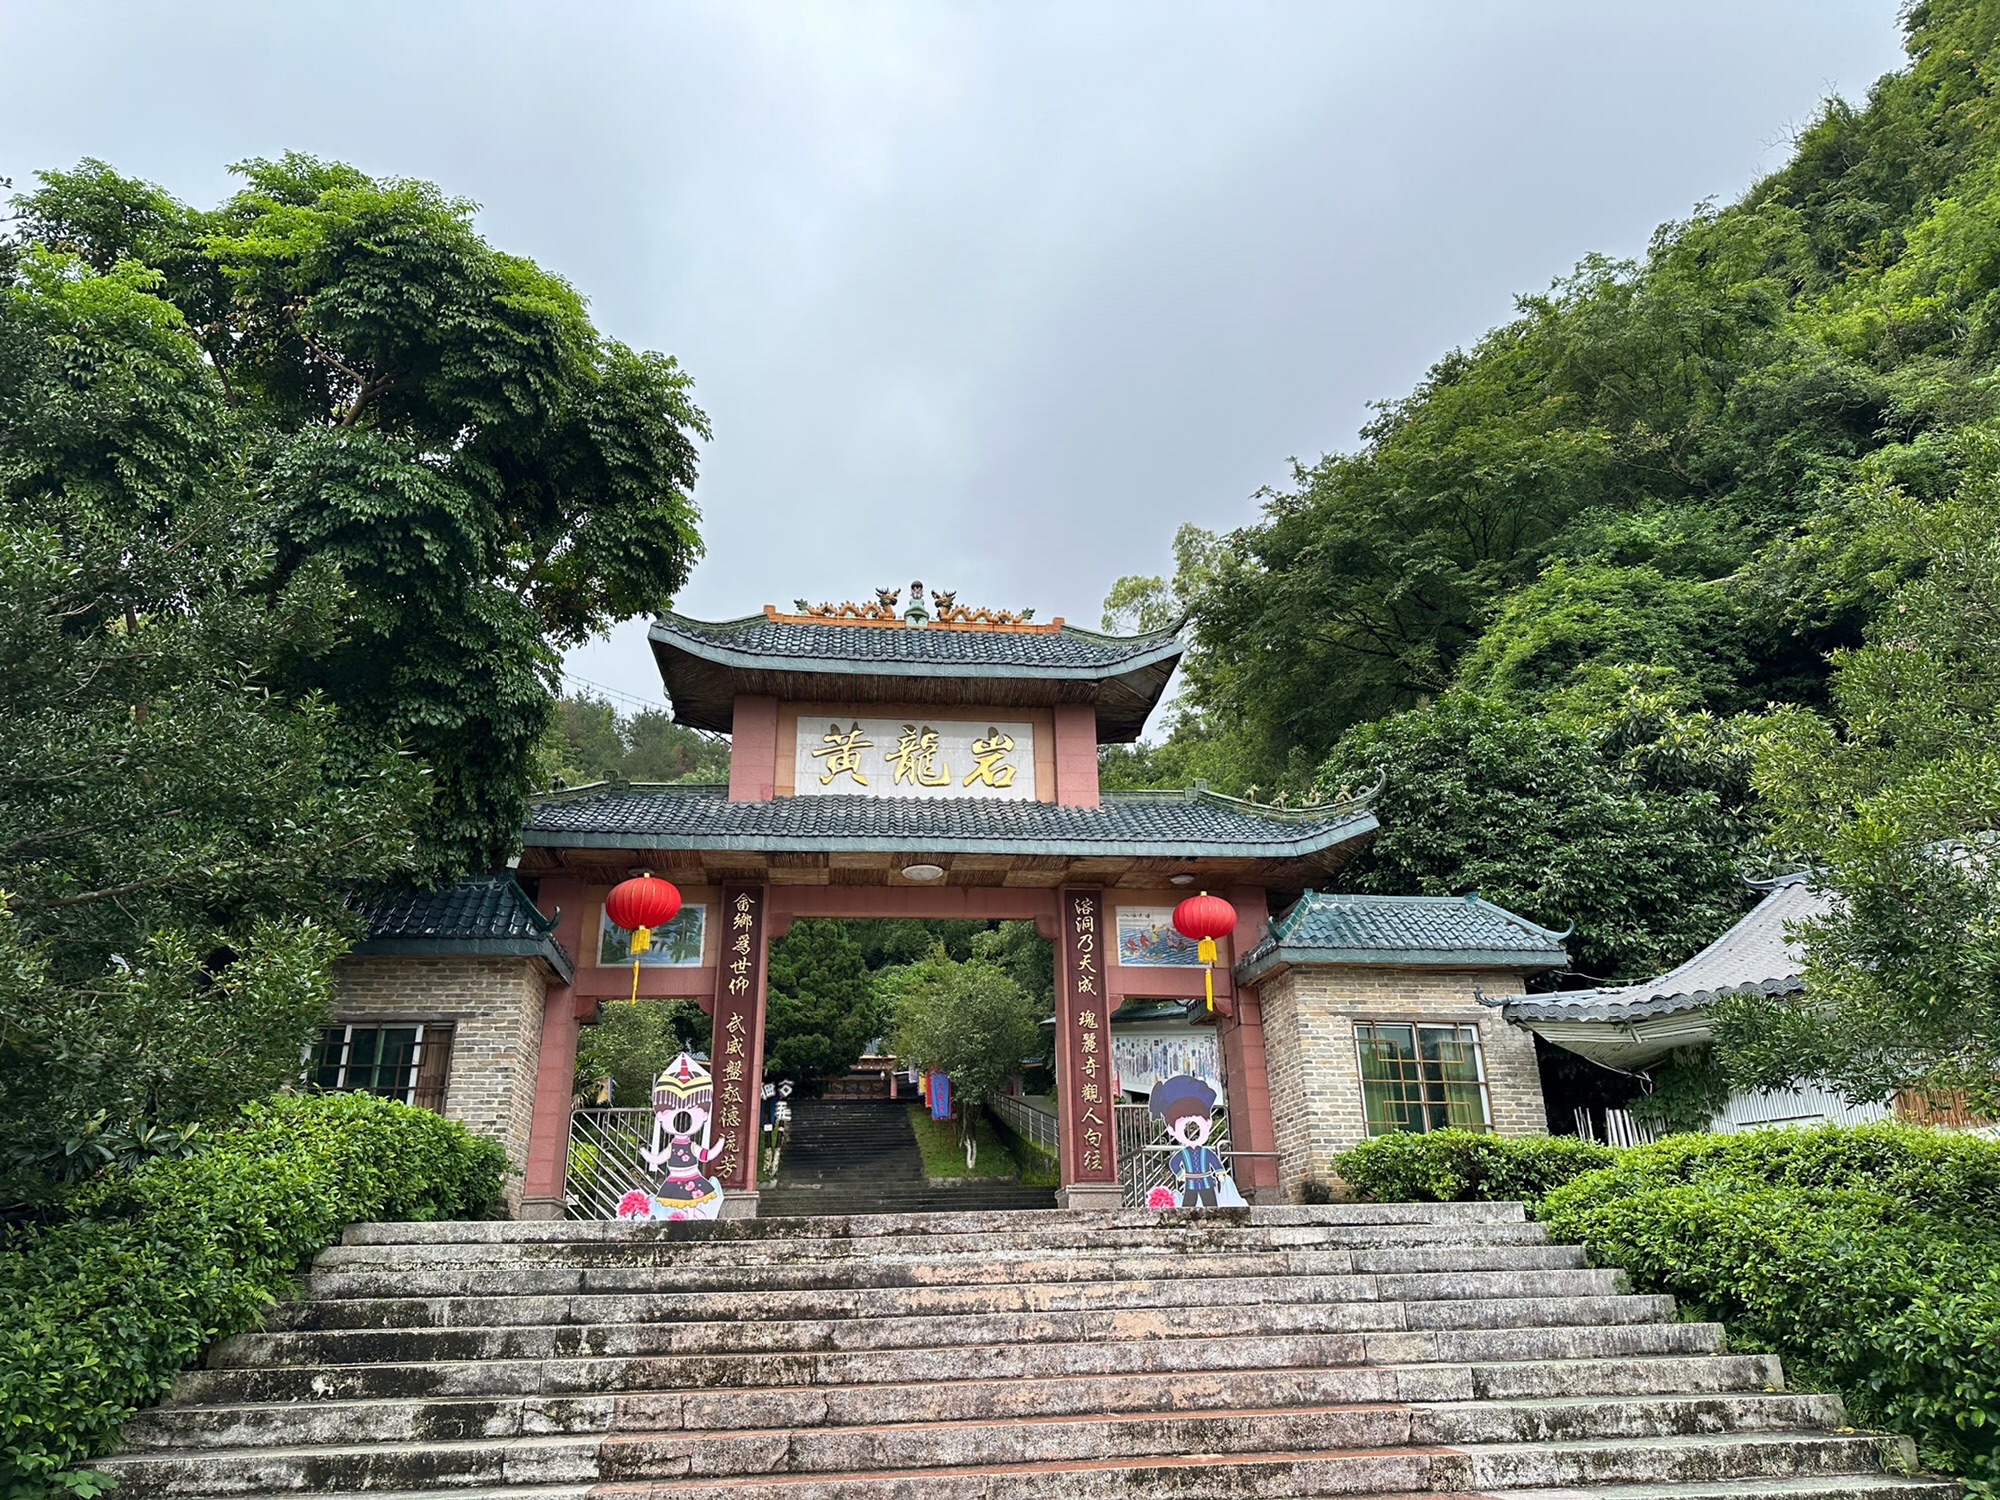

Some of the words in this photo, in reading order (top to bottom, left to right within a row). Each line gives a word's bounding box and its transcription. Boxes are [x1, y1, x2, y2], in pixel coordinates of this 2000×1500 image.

[1075, 897, 1097, 996] 溶洞乃天成
